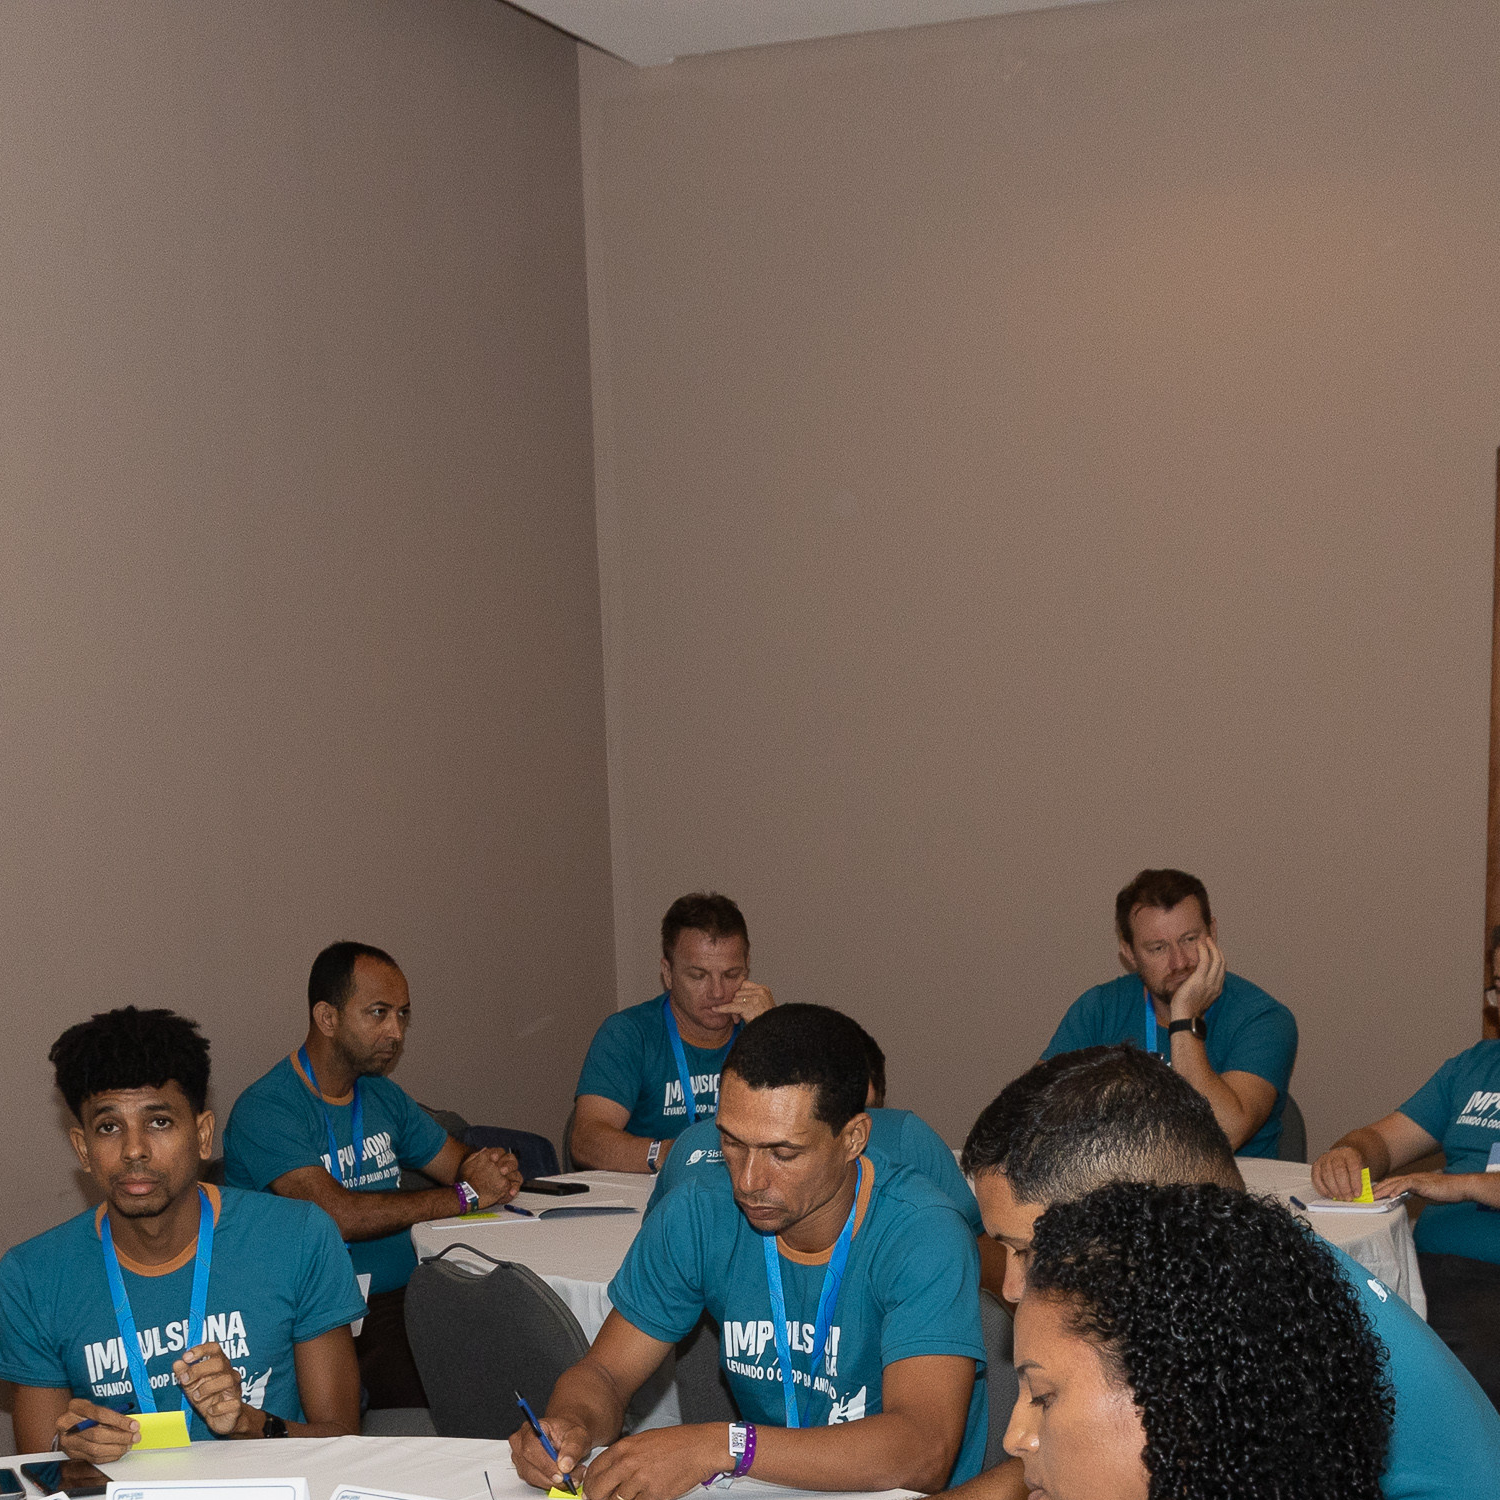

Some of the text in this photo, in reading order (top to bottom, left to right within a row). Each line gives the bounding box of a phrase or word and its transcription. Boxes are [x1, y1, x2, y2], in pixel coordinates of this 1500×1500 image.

[726, 1358, 764, 1381] LEVANDO
[766, 1366, 774, 1382] O
[91, 1380, 133, 1398] LEVANDO
